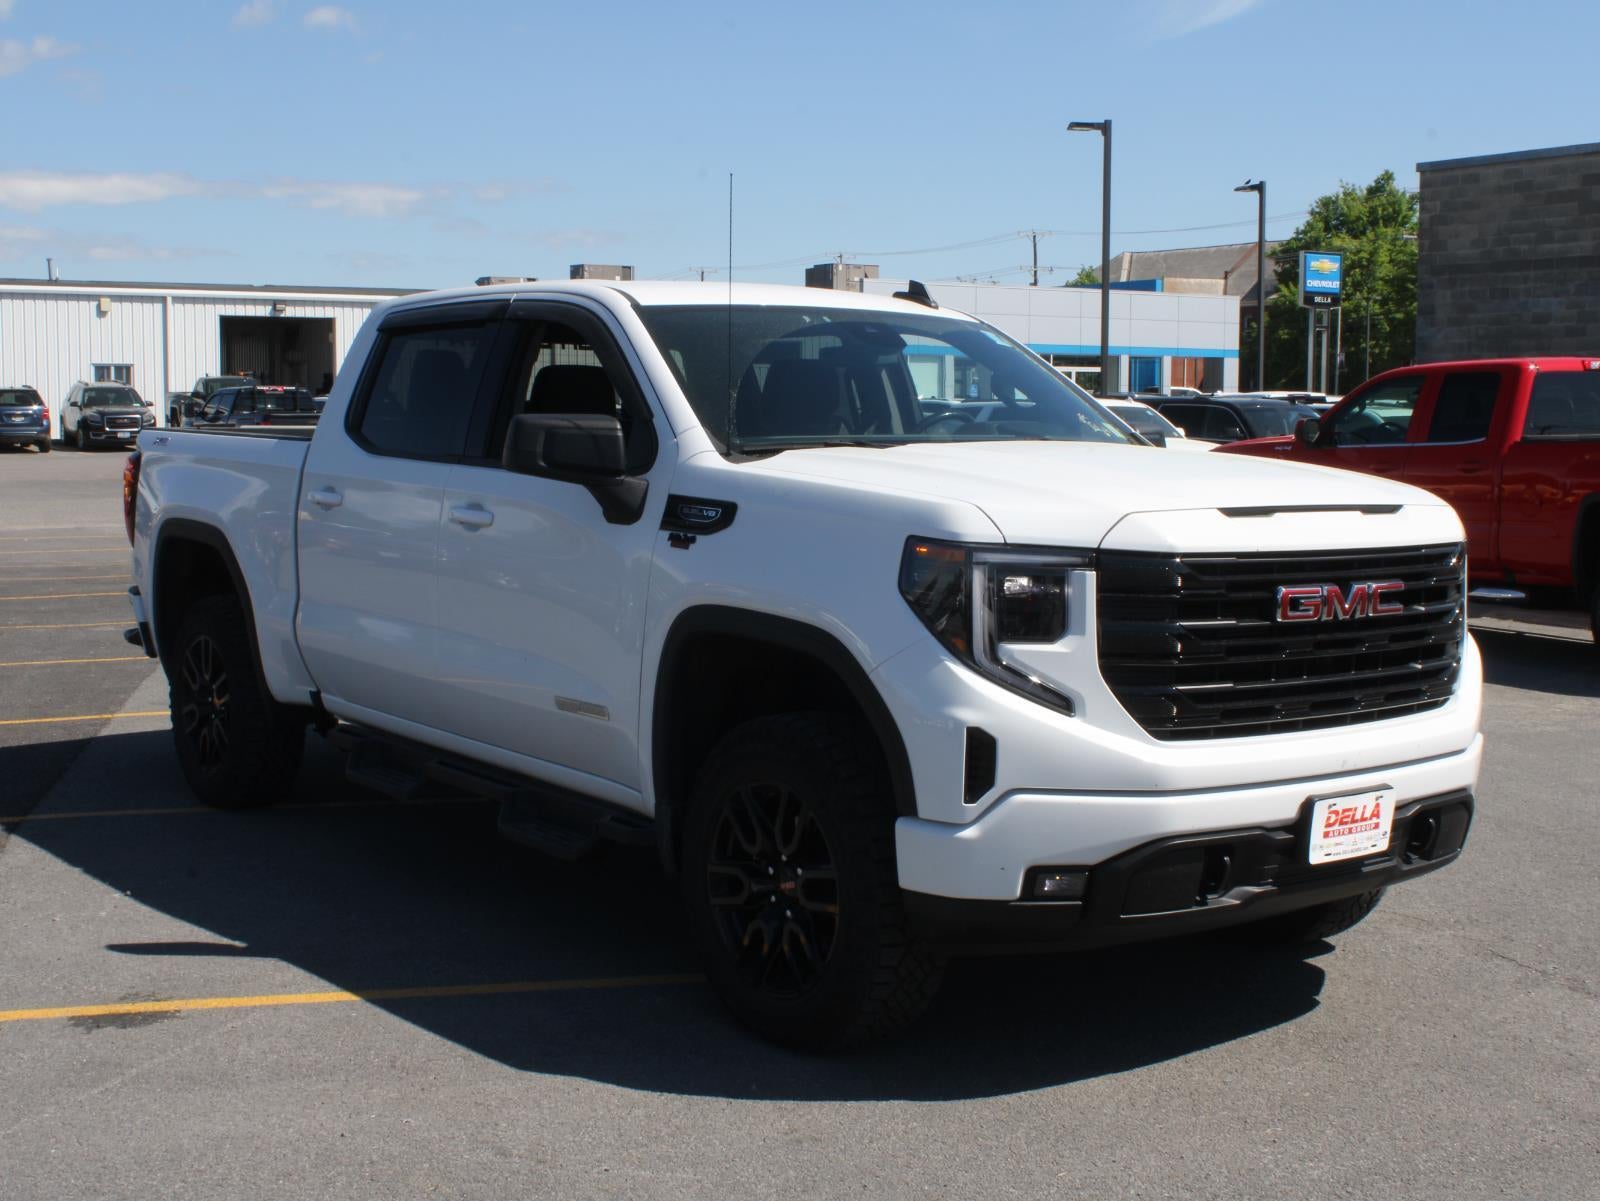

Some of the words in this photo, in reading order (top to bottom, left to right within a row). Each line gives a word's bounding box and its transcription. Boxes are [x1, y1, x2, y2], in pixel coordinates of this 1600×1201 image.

[1306, 280, 1340, 289] CHEVROLET
[1276, 580, 1405, 622] GMC
[1324, 802, 1380, 828] DELLA
[1328, 827, 1350, 838] AUTO
[1351, 823, 1377, 834] GROUP
